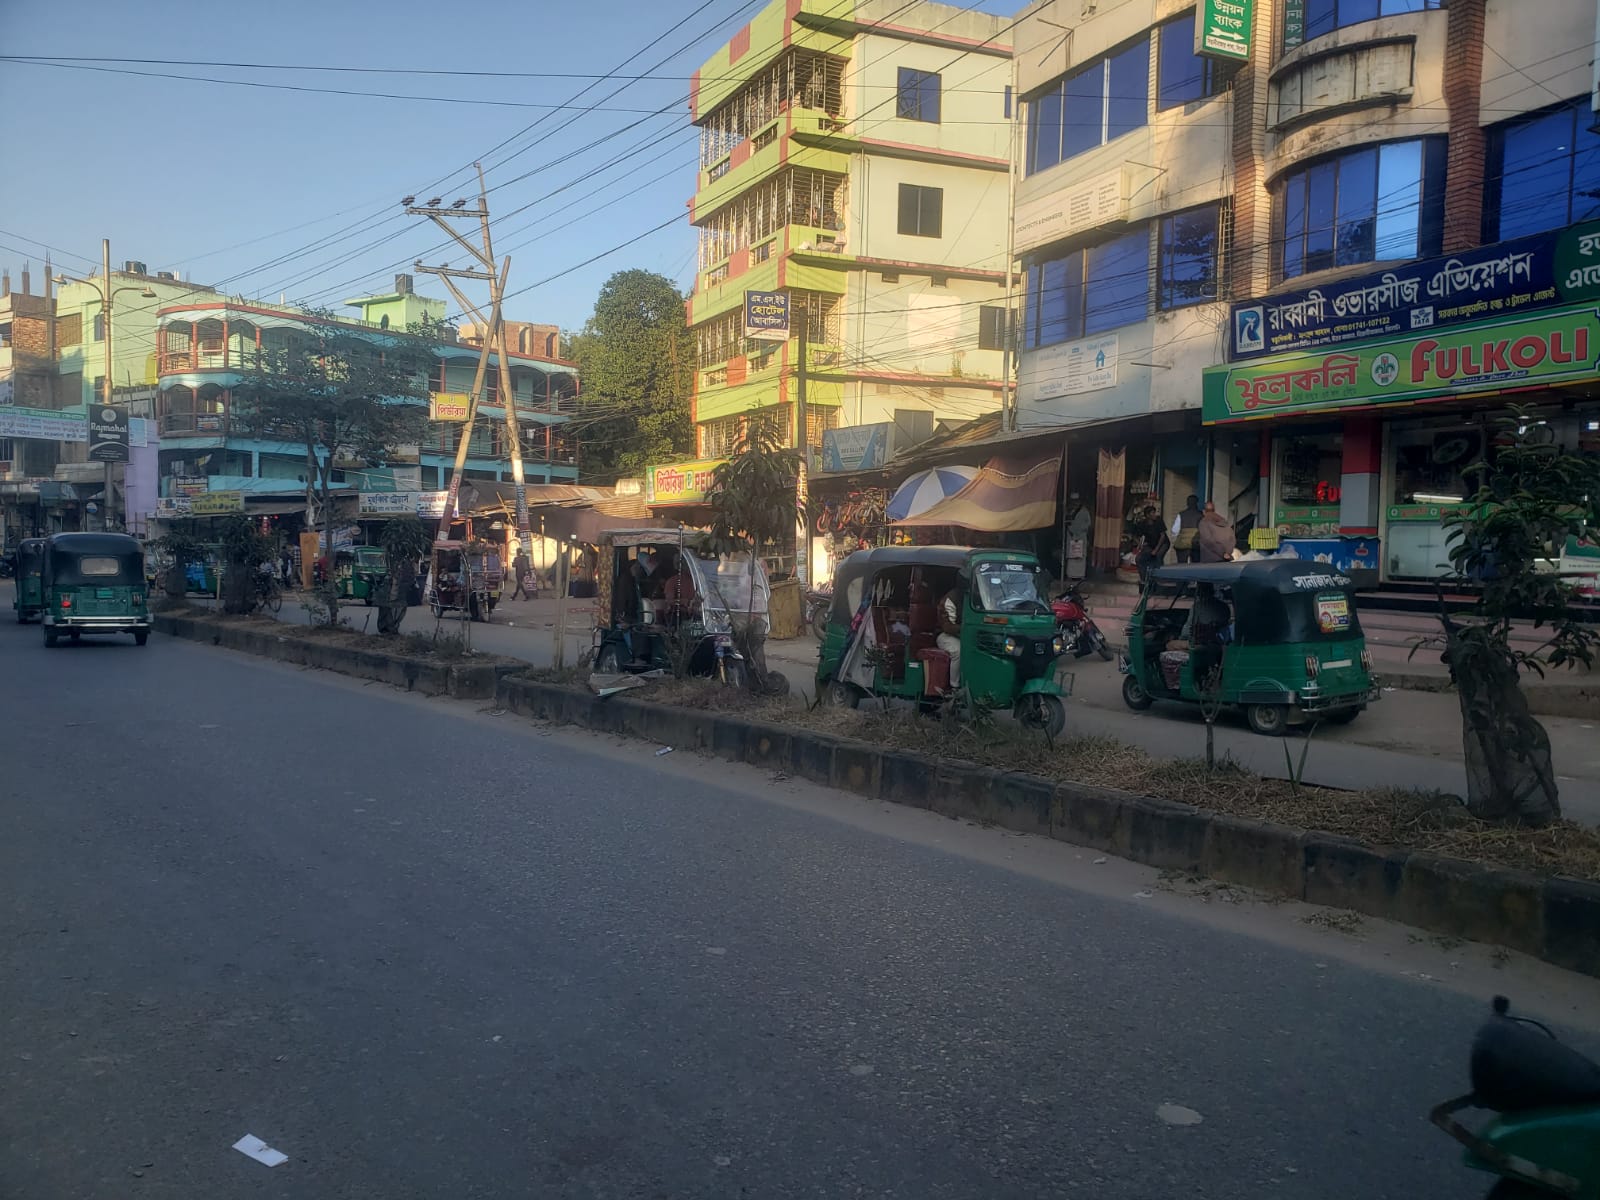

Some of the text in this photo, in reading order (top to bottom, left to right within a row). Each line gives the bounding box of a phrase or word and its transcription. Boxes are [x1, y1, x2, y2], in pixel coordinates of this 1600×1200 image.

[1267, 252, 1535, 331] রাব্বানী ওভারসীজ এভিয়েশন
[1235, 354, 1359, 409] ফুলকলি
[1411, 328, 1588, 383] FULKOLI
[90, 422, 128, 434] Rajmahal
